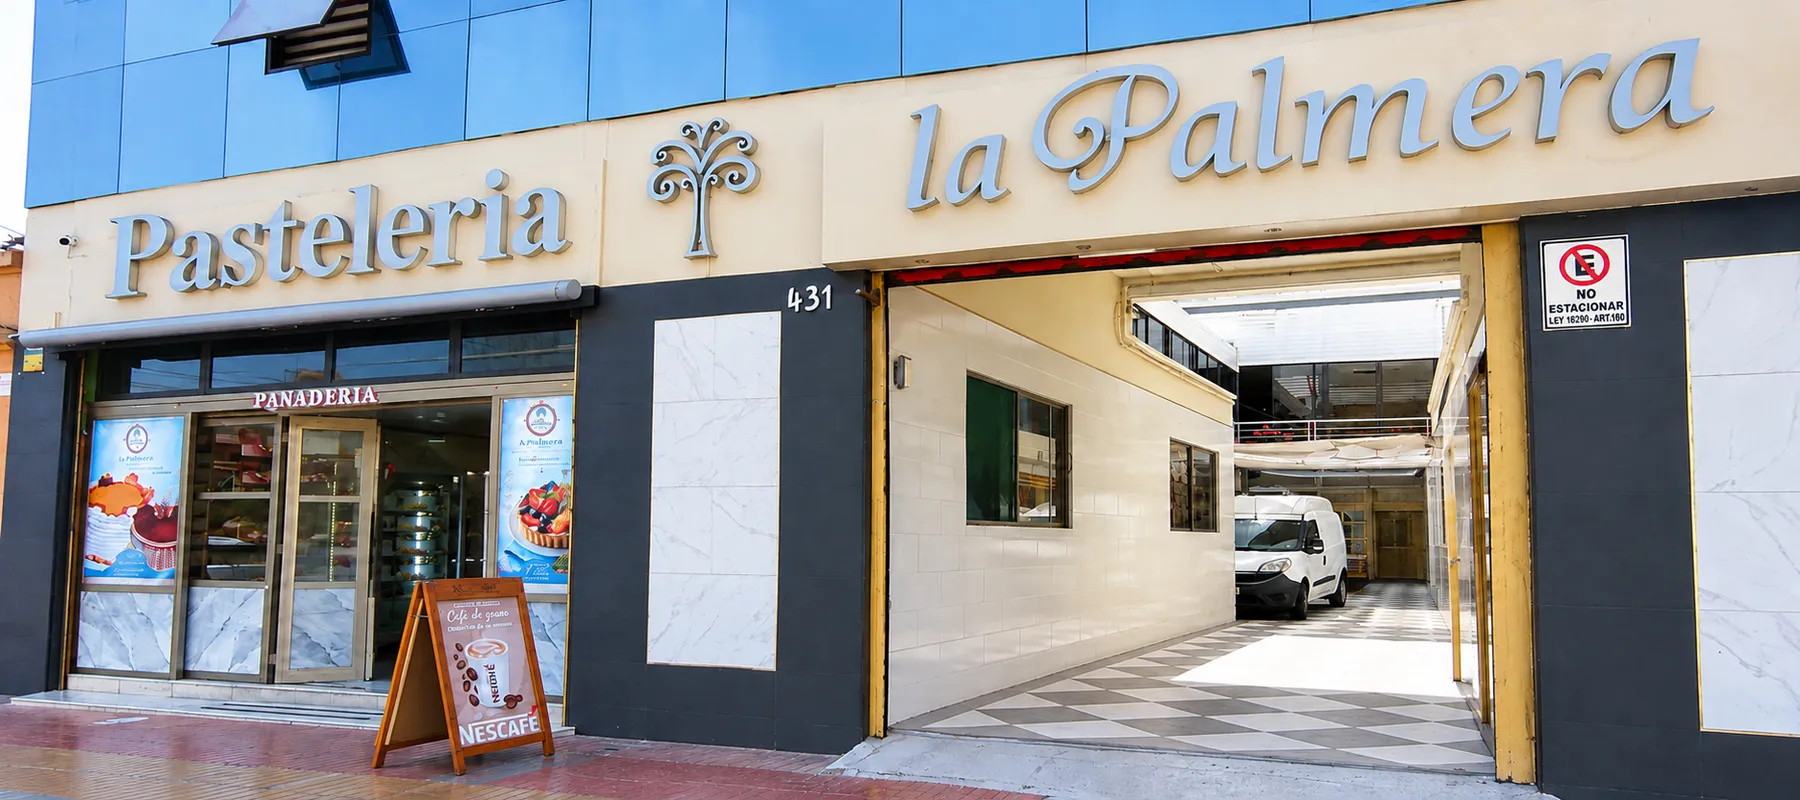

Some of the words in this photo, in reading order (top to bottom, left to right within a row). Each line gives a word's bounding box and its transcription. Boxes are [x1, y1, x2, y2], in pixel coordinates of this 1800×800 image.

[907, 103, 1012, 213] la
[1032, 37, 1715, 195] Palmera
[105, 168, 573, 300] Pasteleria
[787, 284, 831, 312] 431
[1576, 288, 1596, 300] NO
[1548, 301, 1624, 314] ESTACIONAR
[1549, 316, 1565, 325] LEY
[253, 386, 378, 409] PANADERIA
[471, 607, 482, 619] de
